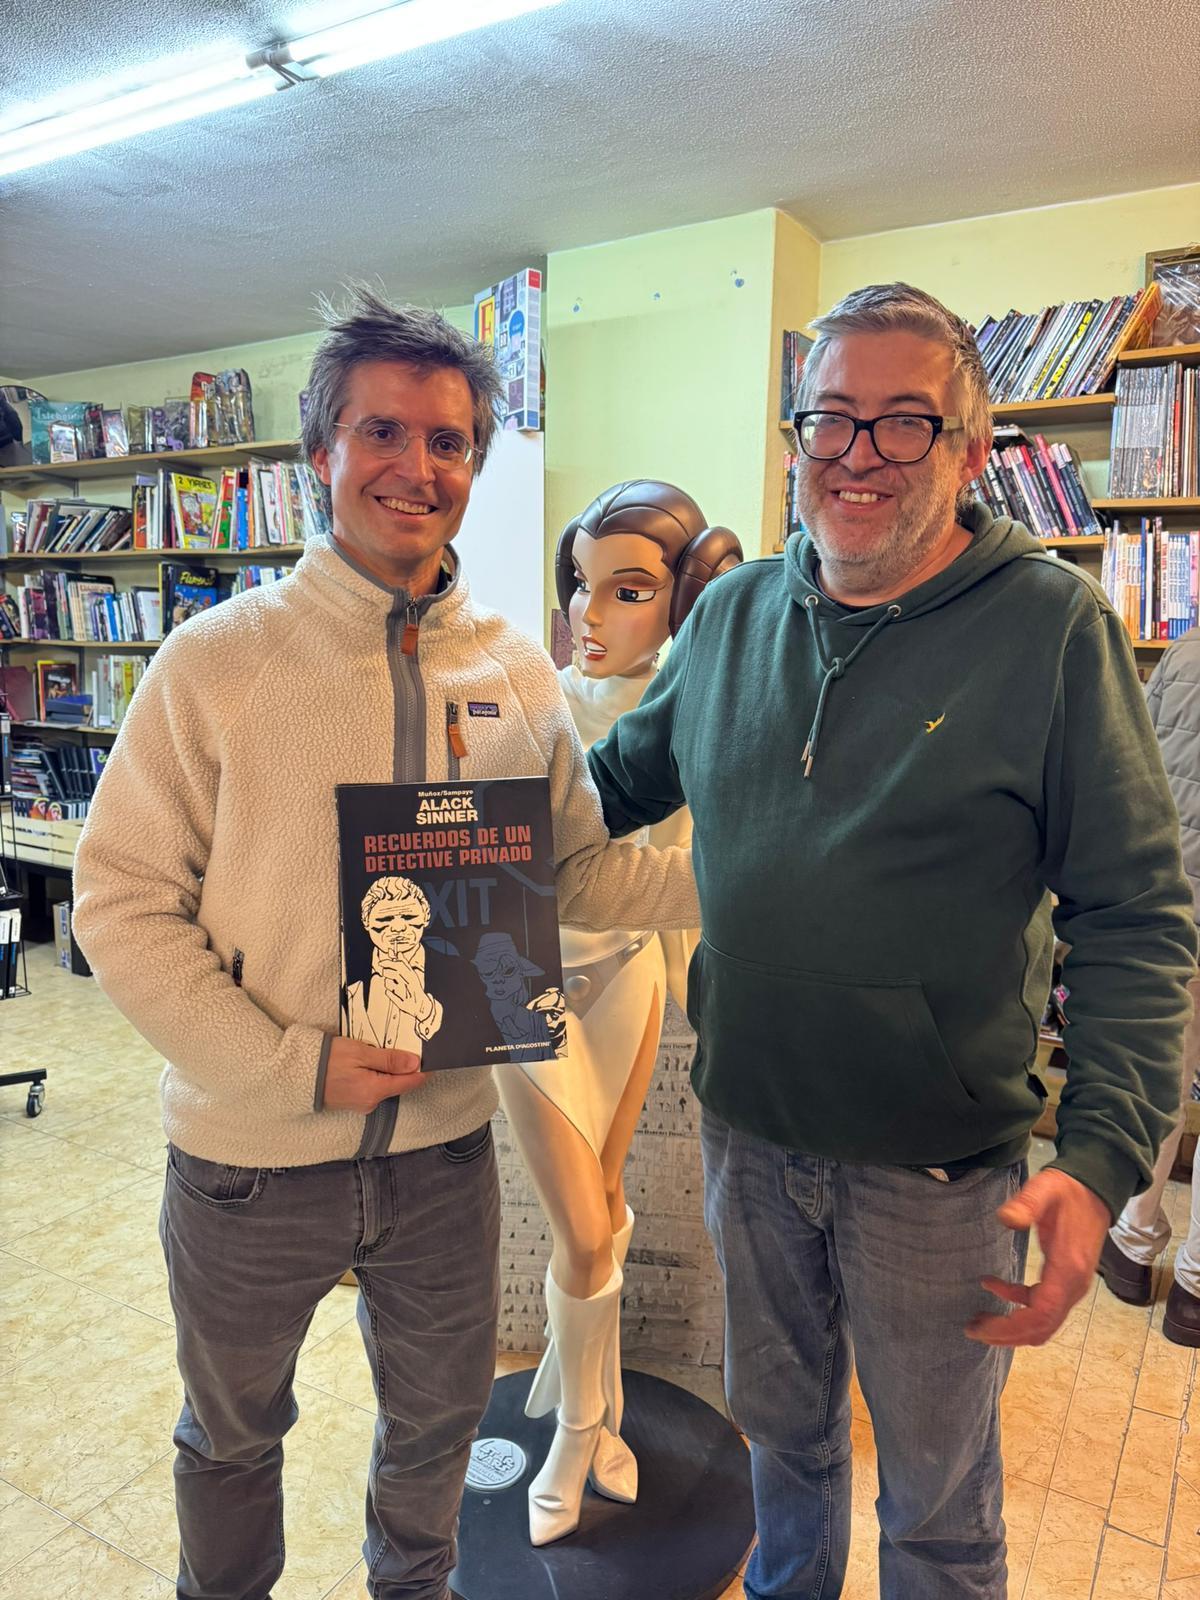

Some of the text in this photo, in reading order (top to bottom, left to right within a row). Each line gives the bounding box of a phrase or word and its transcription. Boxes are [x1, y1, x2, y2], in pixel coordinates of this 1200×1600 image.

[990, 480, 1004, 502] KIRBY
[419, 797, 475, 812] ALACK
[416, 809, 479, 825] SINNER
[364, 825, 532, 854] RECUERDOS DE UN
[365, 845, 533, 873] DETECTIVE PRIVADO
[423, 877, 498, 928] XIT
[485, 1044, 515, 1053] PLANETA
[476, 1451, 515, 1473] WARS
[478, 1442, 515, 1467] STAR
